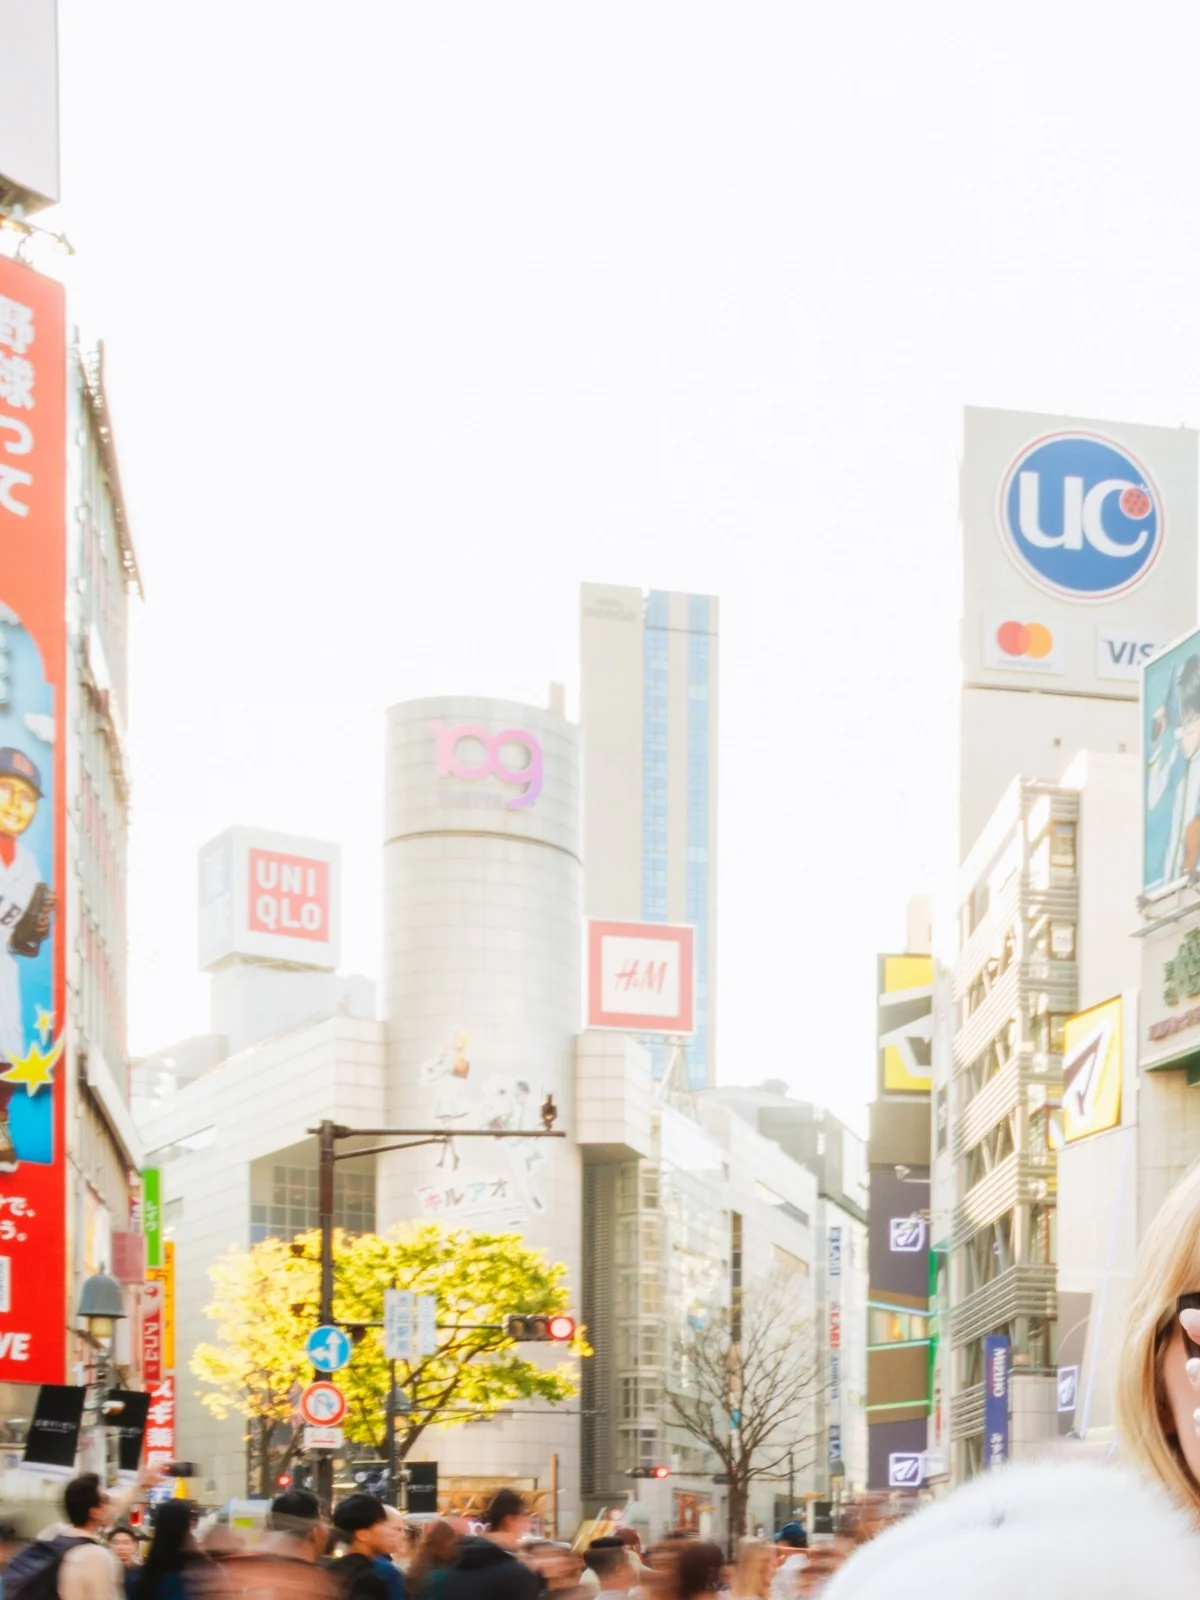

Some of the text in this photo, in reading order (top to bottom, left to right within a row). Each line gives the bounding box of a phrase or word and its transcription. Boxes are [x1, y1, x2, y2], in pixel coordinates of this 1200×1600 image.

[1102, 639, 1170, 668] VIS
[427, 718, 543, 811] 109
[256, 859, 316, 896] UNI
[256, 895, 321, 930] QLO
[614, 959, 668, 993] H&M
